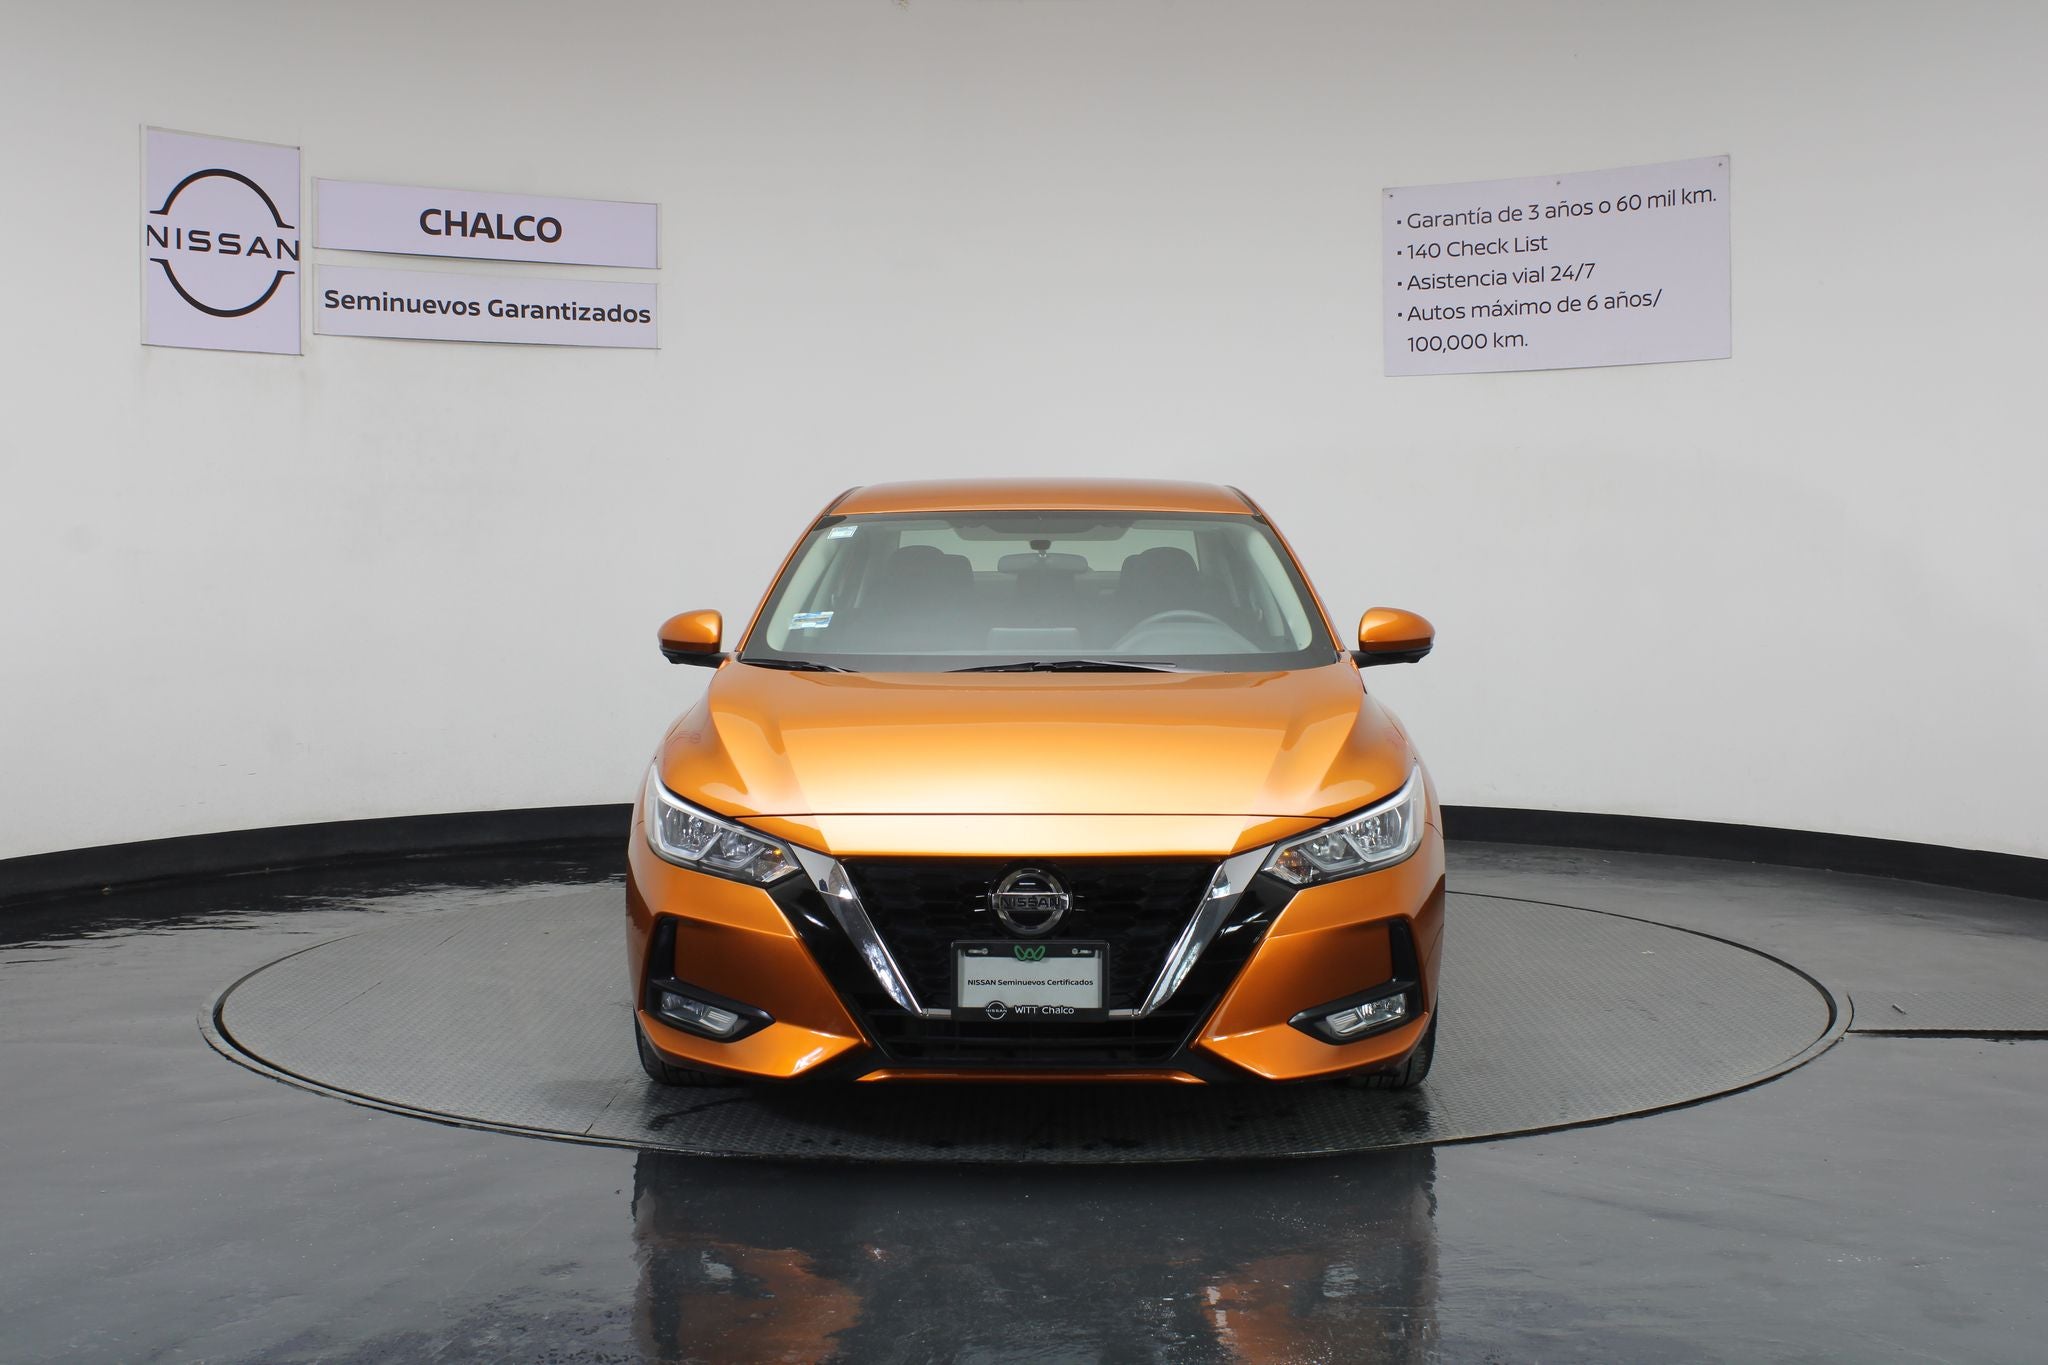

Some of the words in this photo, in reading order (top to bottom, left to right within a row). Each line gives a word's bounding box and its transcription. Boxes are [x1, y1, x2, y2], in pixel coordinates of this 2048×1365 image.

[1407, 207, 1492, 229] Garantía
[1498, 205, 1523, 223] de
[1528, 204, 1540, 221] 3
[1545, 199, 1593, 219] años
[1599, 200, 1611, 214] o
[1616, 194, 1642, 212] 60
[1647, 189, 1676, 209] mil
[1681, 187, 1717, 205] km.
[419, 208, 563, 243] CHALCO
[146, 224, 300, 262] NISSAN
[1407, 242, 1441, 260] 140
[1447, 238, 1509, 257] Check
[1514, 235, 1548, 252] List
[1407, 269, 1507, 291] Asistencia
[1512, 266, 1545, 284] vial
[1550, 262, 1596, 283] 24/7
[324, 289, 481, 318] Seminuevos
[487, 299, 651, 324] Garantizados
[1407, 305, 1466, 322] Autos
[1471, 300, 1551, 319] máximo
[1557, 296, 1582, 313] de
[1586, 294, 1599, 311] 6
[1604, 289, 1663, 309] años/
[1407, 333, 1487, 354] 100,000
[1493, 332, 1528, 348] km.
[1001, 897, 1061, 909] NISSAN
[1014, 1006, 1038, 1014] WITT
[1041, 1005, 1075, 1015] Chalco
